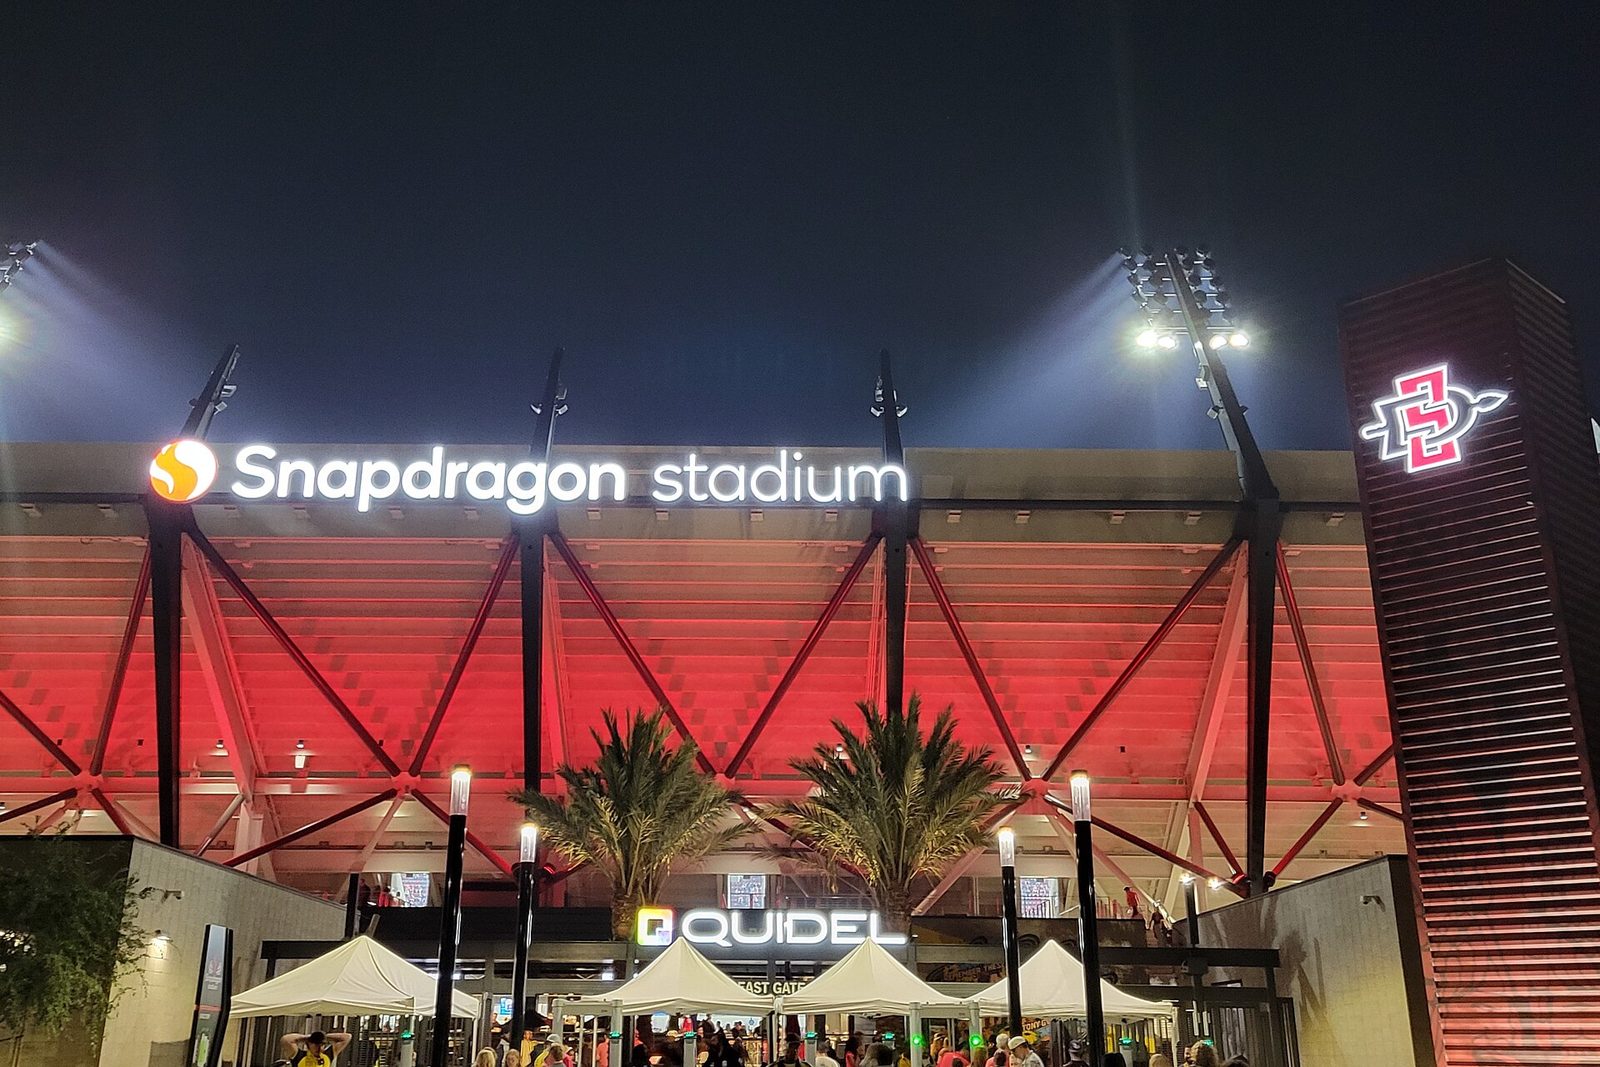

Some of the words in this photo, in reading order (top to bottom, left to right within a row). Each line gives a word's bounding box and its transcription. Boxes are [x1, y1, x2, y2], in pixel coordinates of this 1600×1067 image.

[230, 444, 627, 516] Snapdragon
[651, 448, 909, 503] stadium
[680, 910, 908, 948] QUIDEL
